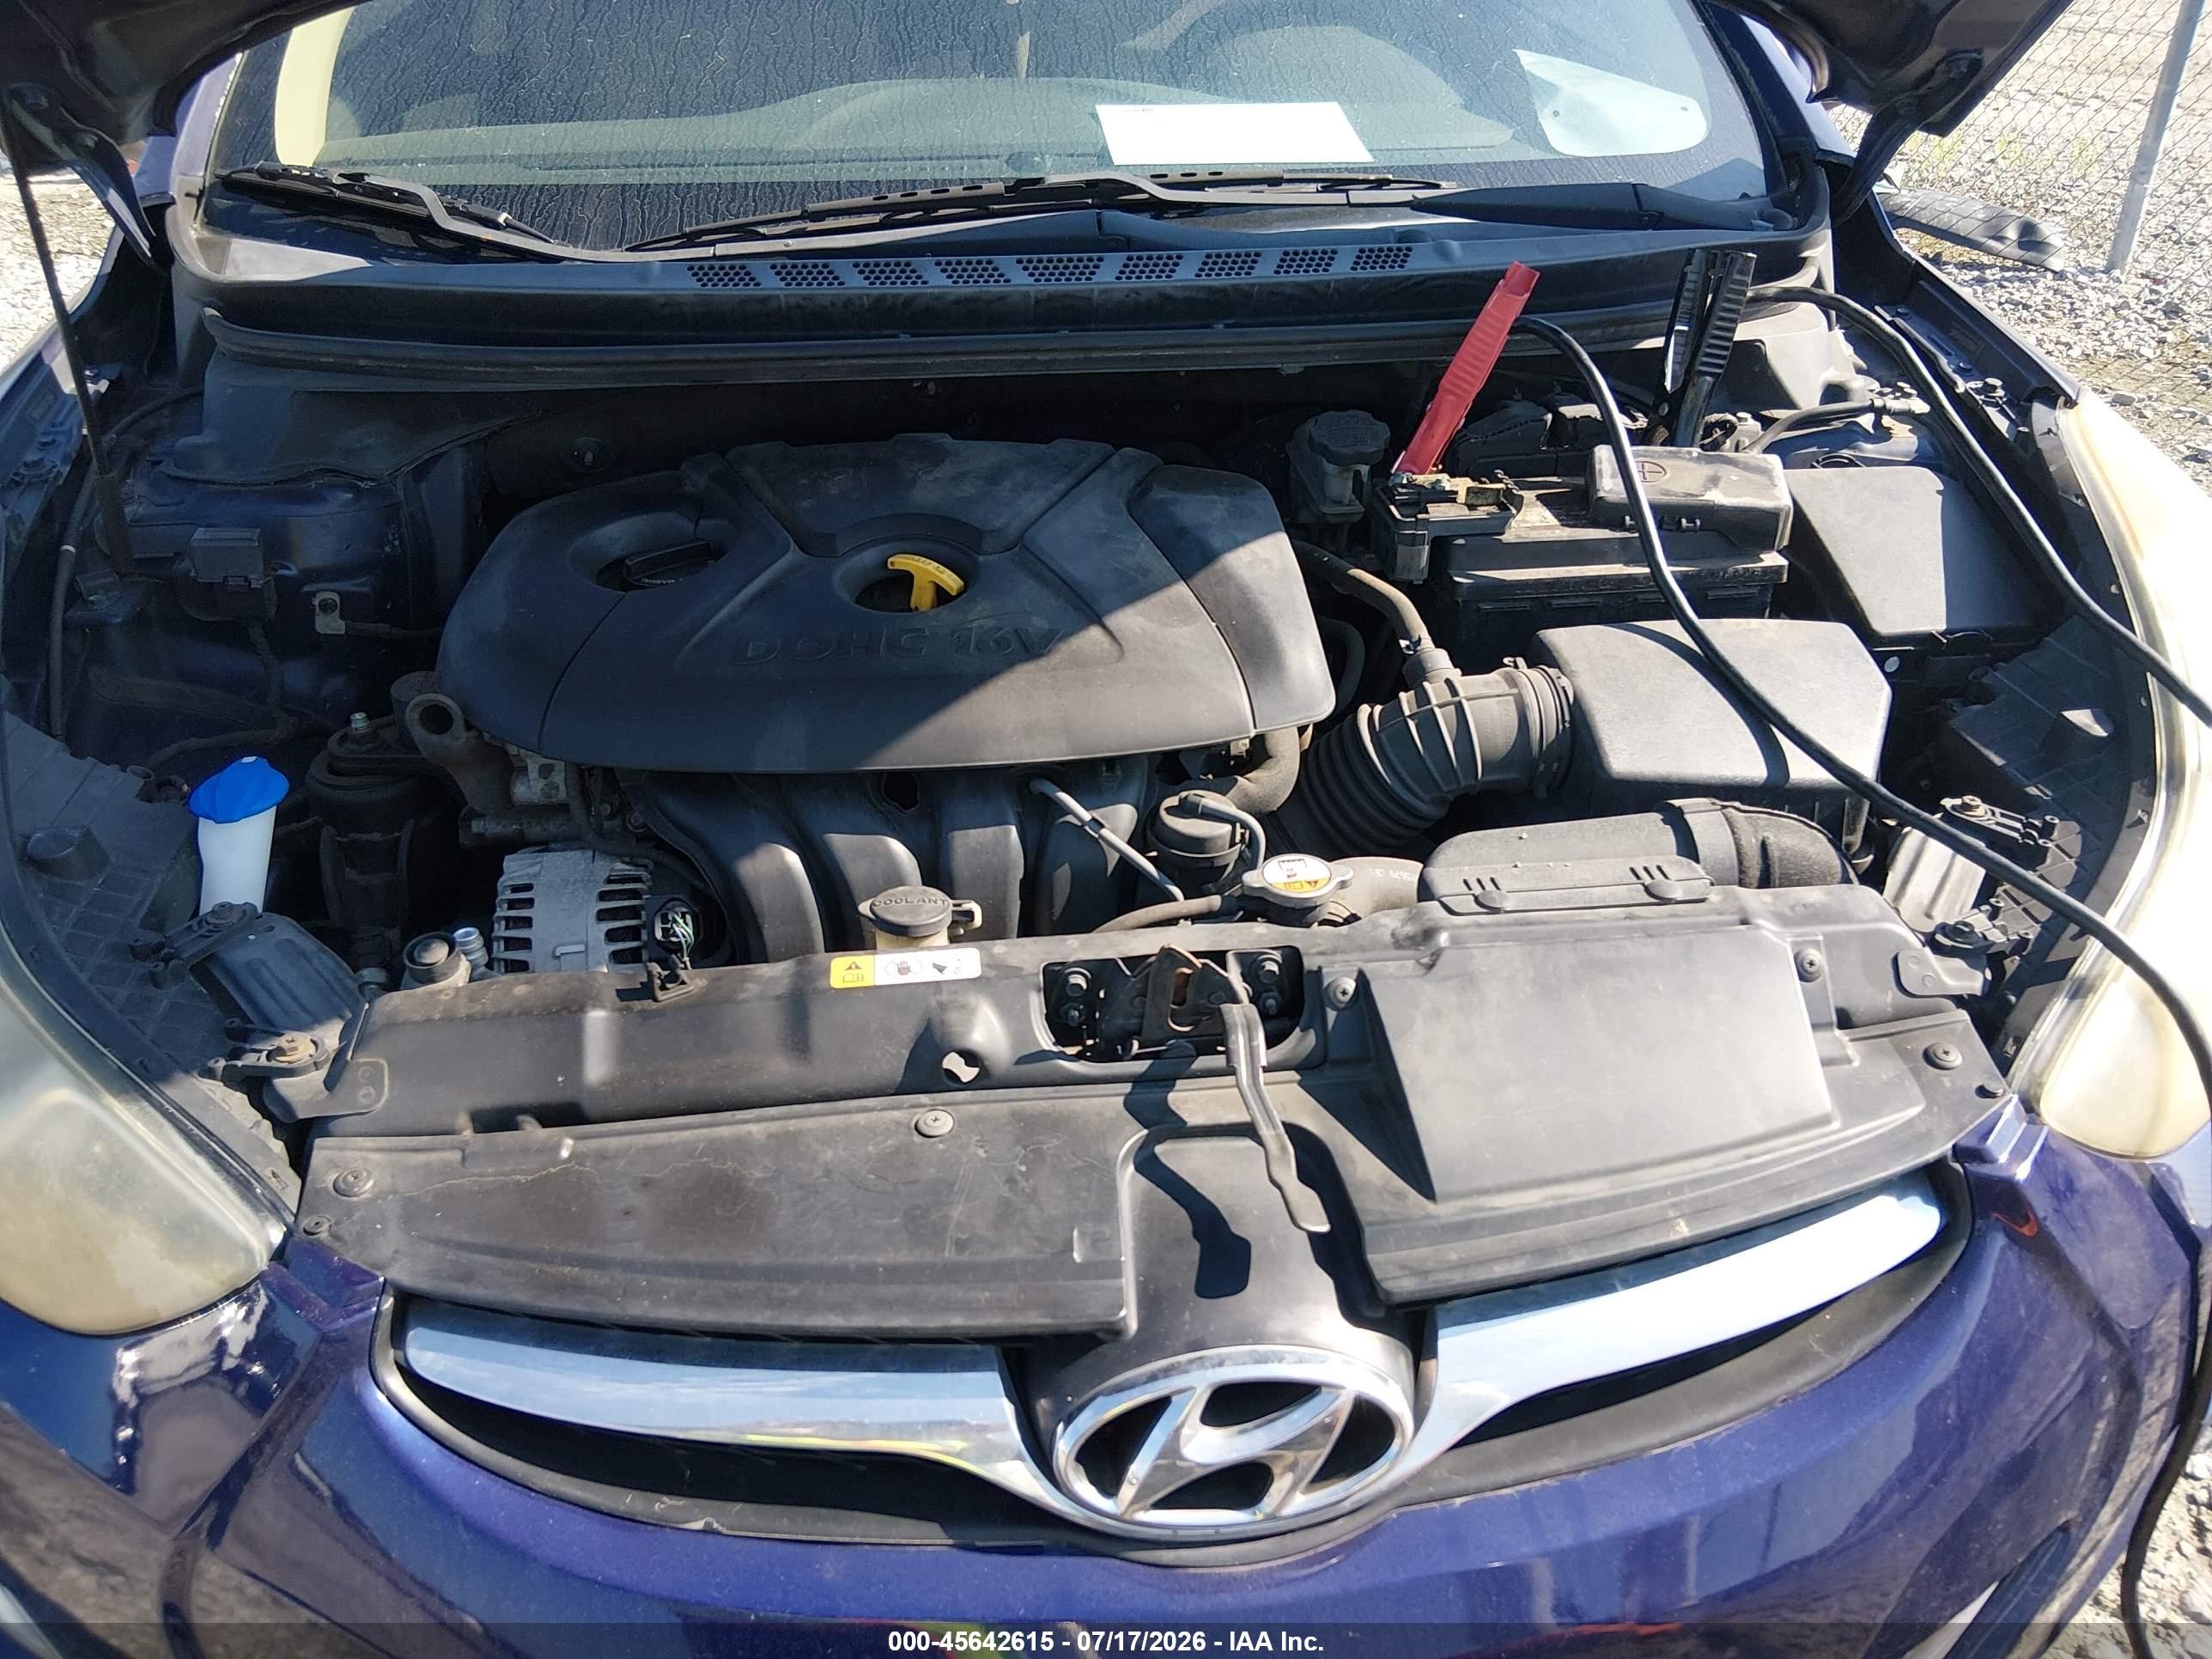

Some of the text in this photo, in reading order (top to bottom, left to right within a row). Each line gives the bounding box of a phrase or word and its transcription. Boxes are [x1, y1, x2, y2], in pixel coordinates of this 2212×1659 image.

[734, 625, 1065, 665] DOHC 16V
[872, 896, 949, 908] COOLANT
